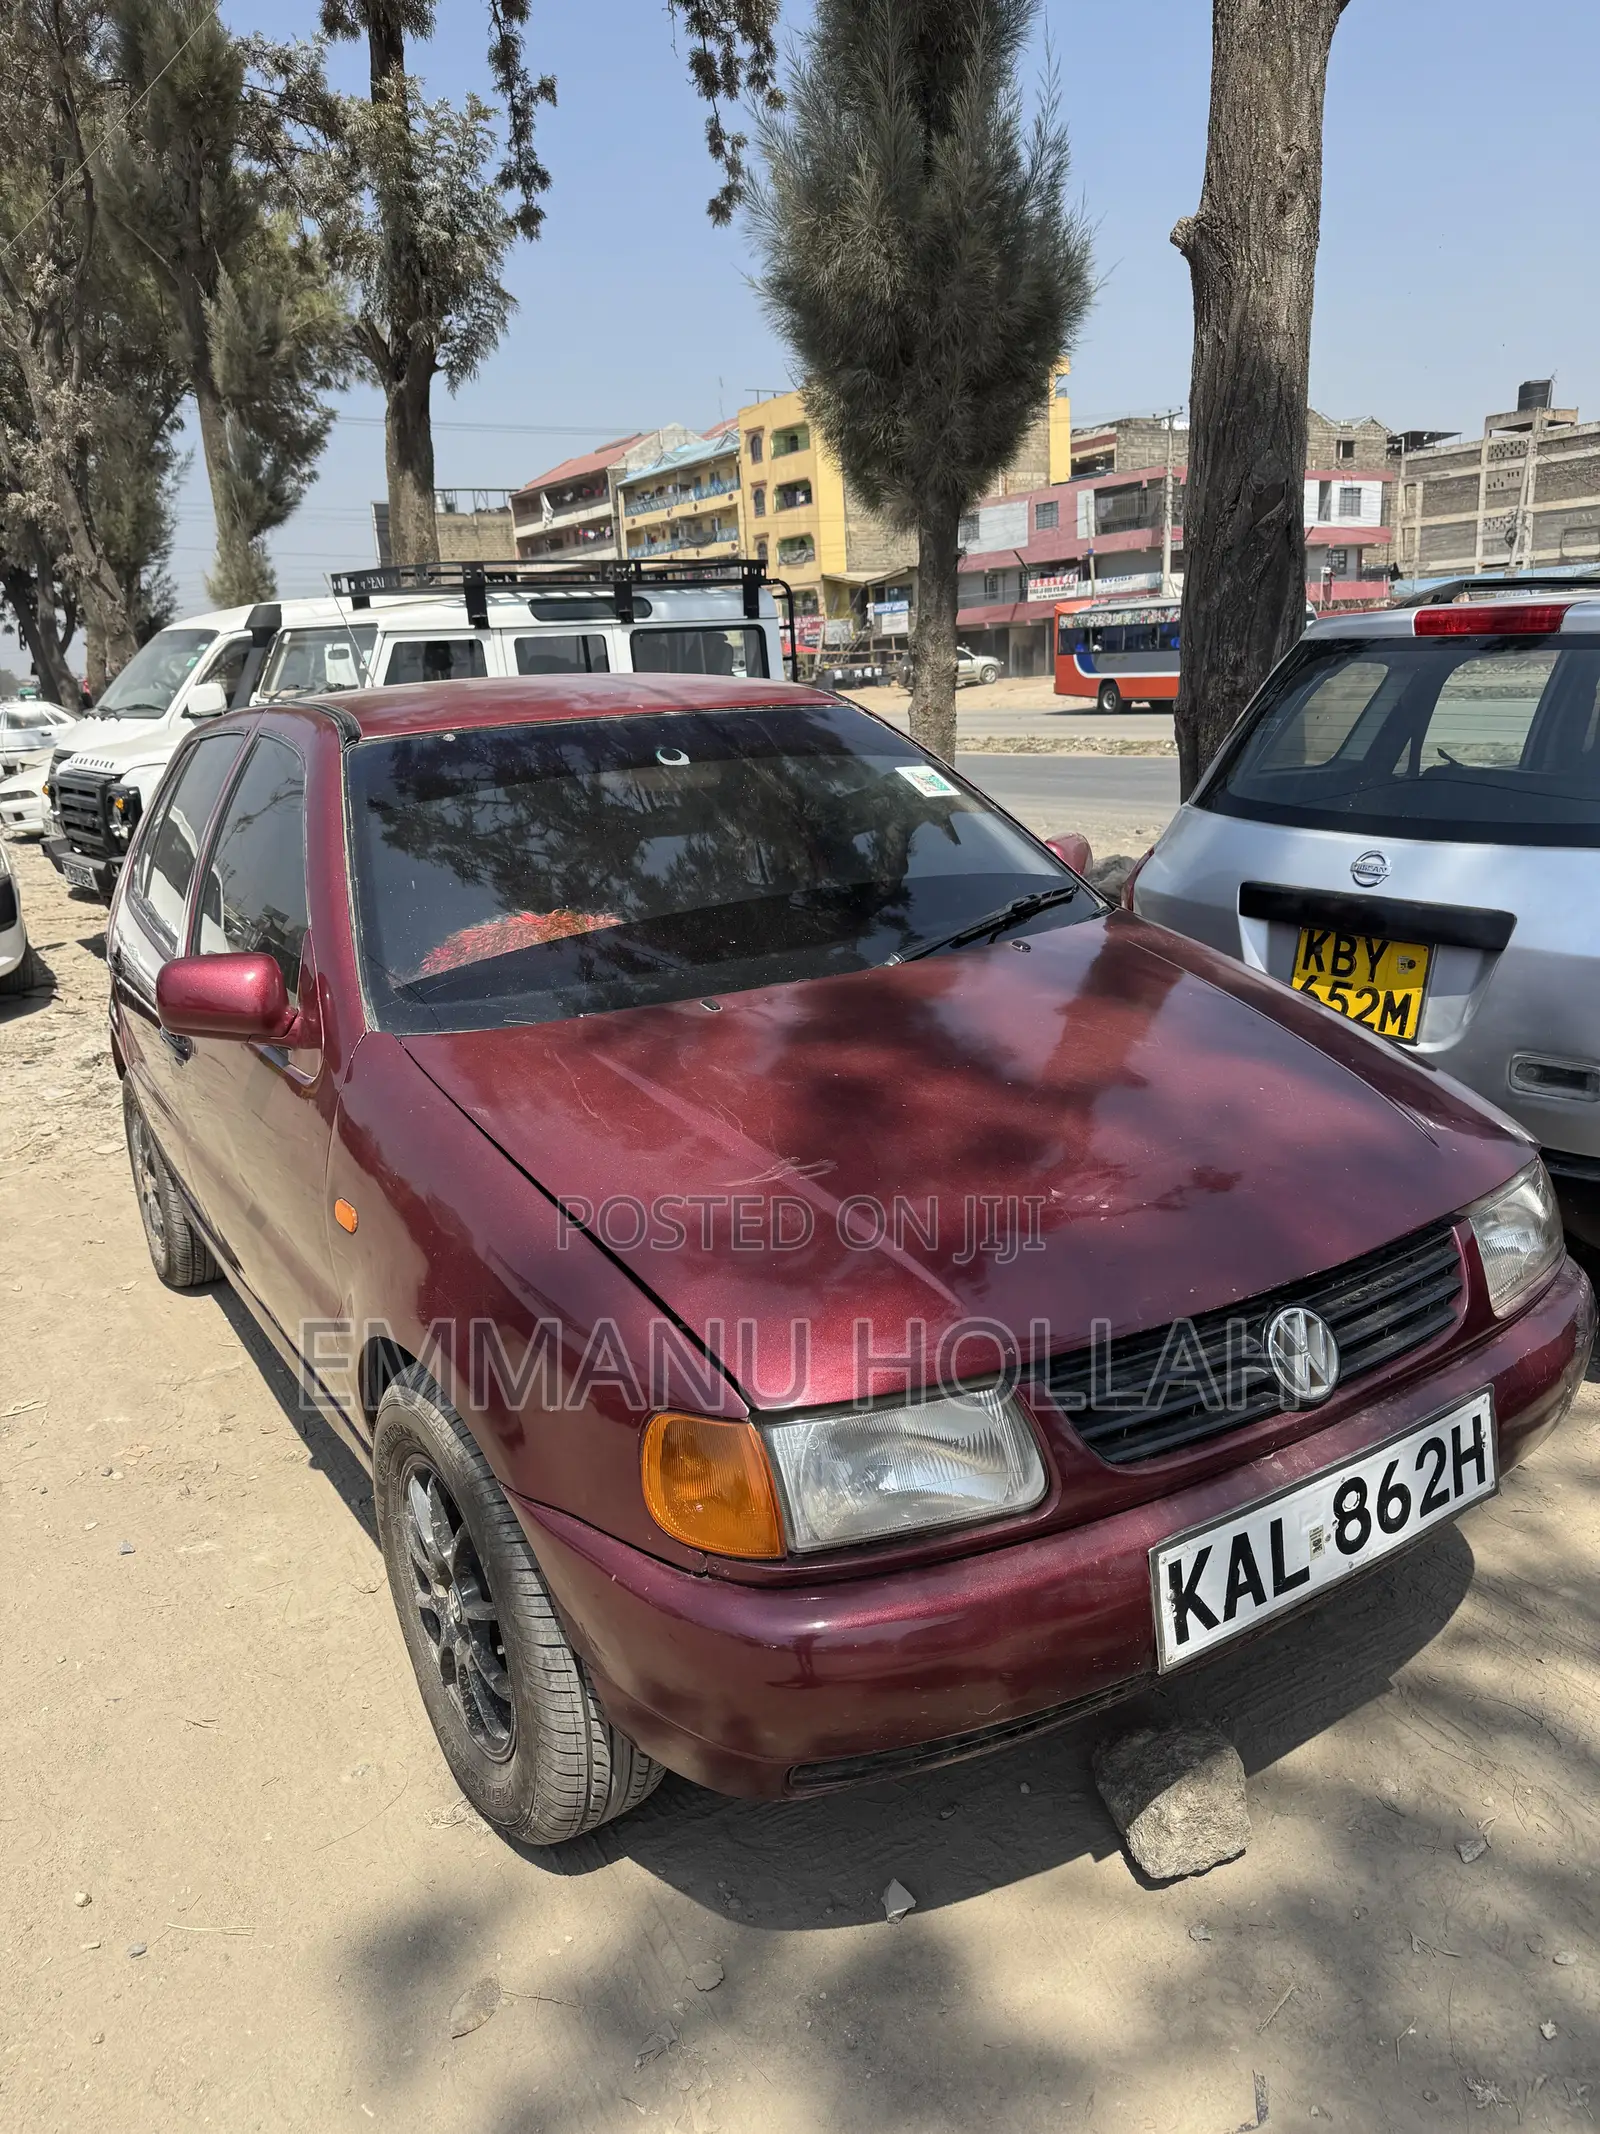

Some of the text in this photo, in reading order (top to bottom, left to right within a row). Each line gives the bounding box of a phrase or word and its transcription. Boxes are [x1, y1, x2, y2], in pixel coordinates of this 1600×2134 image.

[1354, 864, 1386, 874] NISSAN
[1302, 929, 1389, 983] KBY
[1168, 1414, 1487, 1646] KAL 862H
